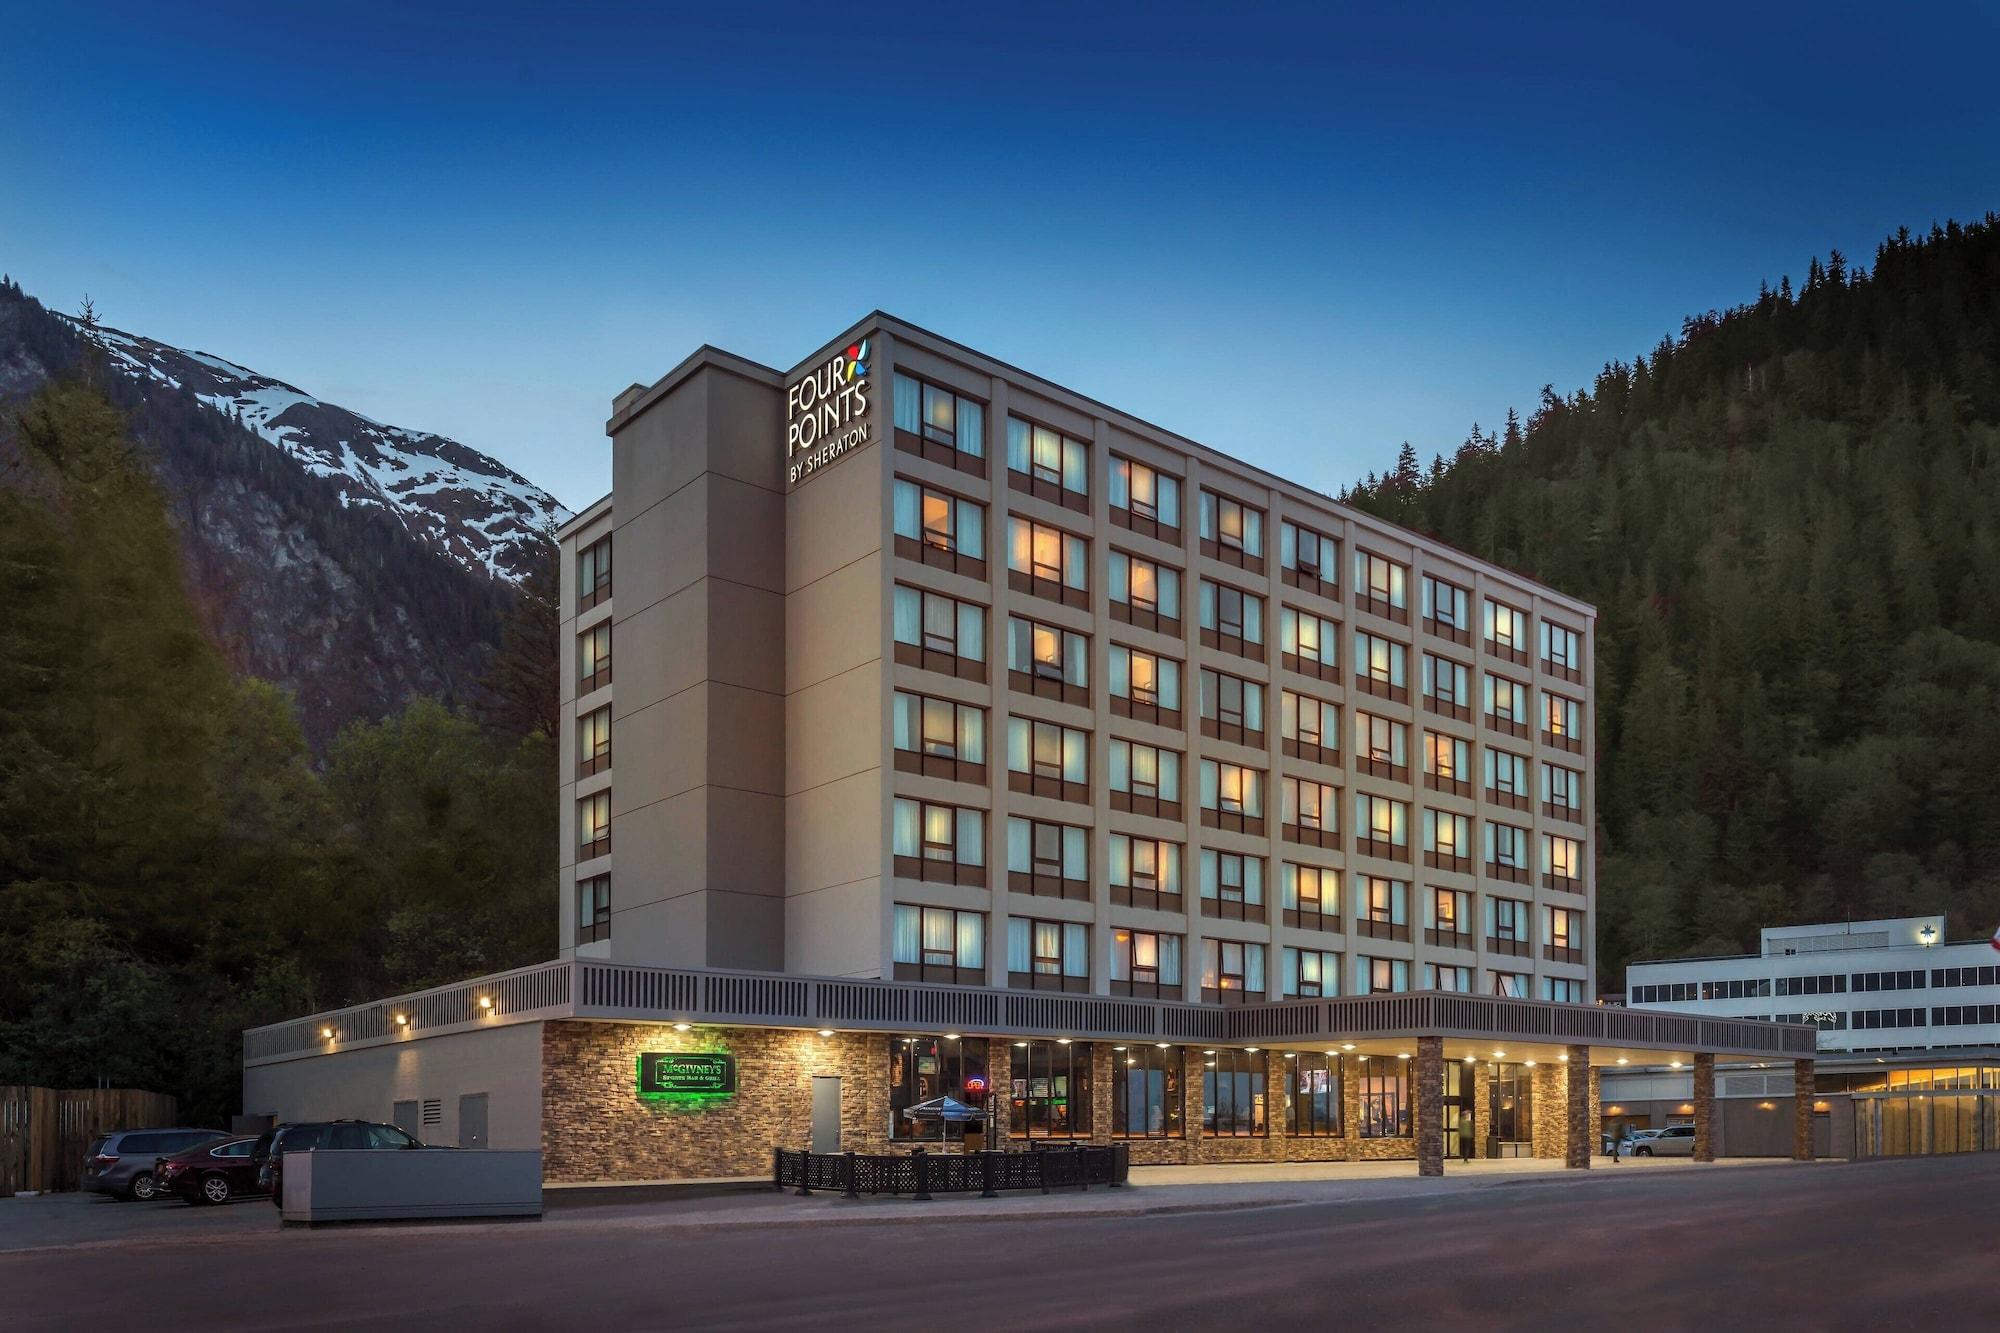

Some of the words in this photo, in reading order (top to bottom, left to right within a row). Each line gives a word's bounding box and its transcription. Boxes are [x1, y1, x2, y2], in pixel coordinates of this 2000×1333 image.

[788, 355, 846, 421] FOUR
[788, 379, 867, 458] POINTS
[790, 461, 804, 483] BY
[807, 423, 868, 473] SHERATON
